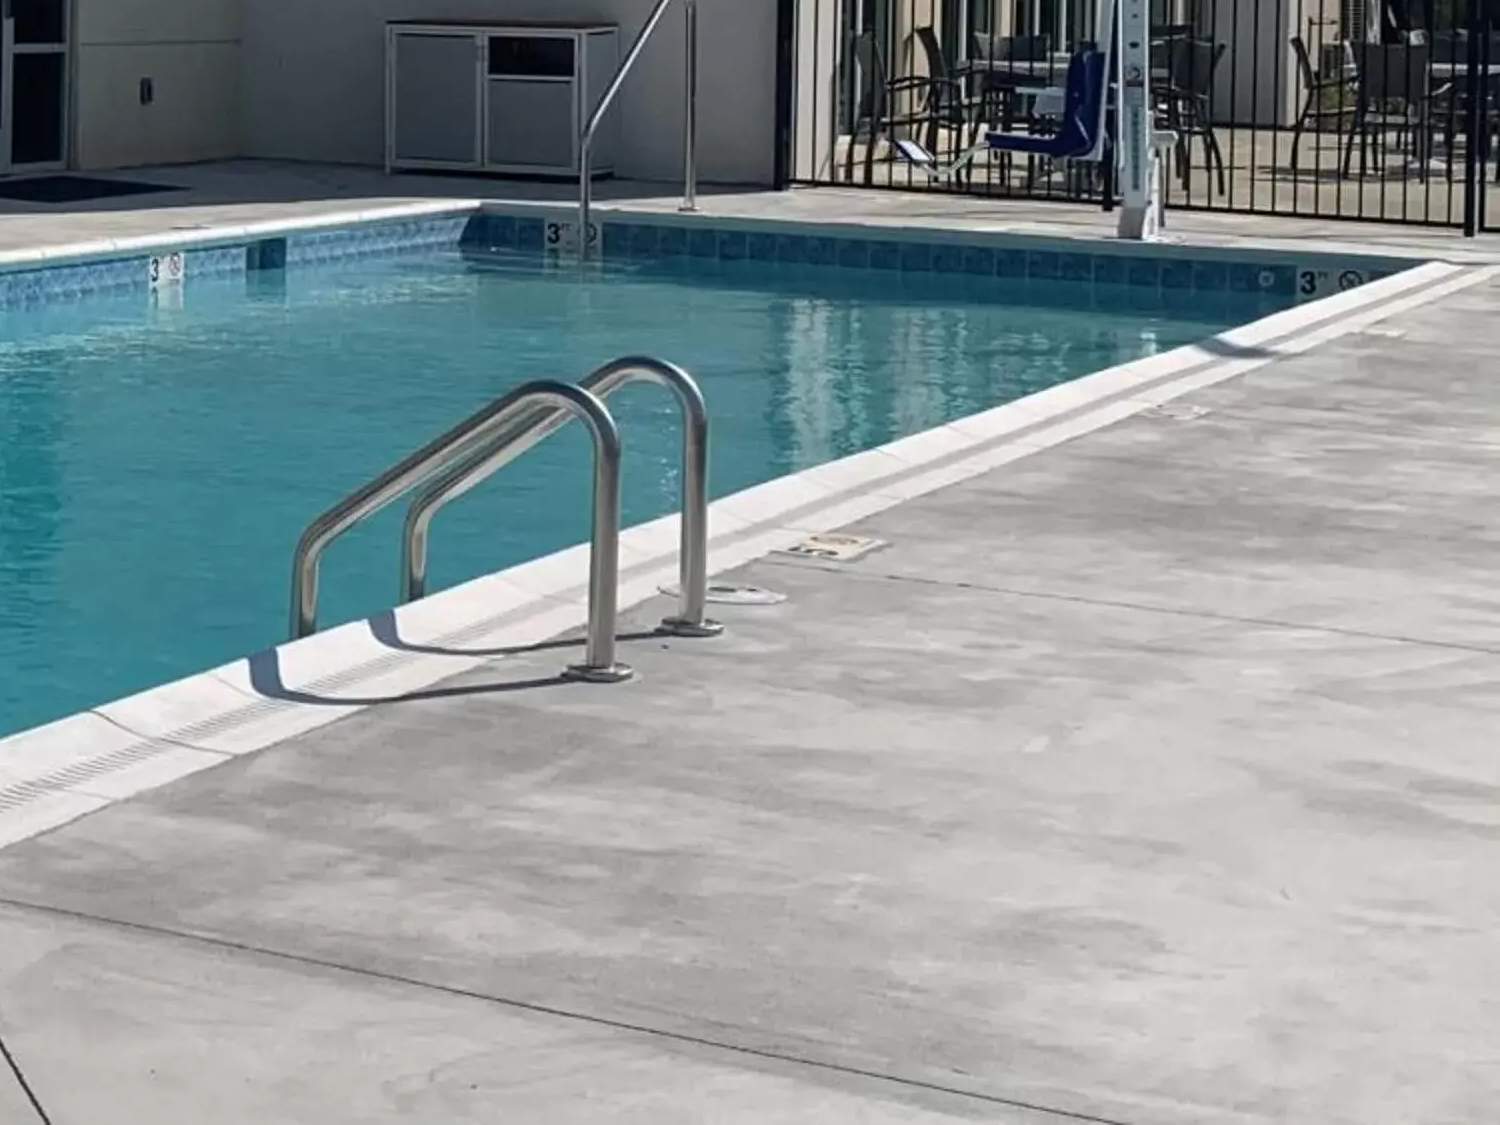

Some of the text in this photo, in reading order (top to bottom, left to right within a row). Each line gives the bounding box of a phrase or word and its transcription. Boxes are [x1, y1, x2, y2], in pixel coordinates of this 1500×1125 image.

[547, 222, 560, 244] 3
[151, 257, 159, 282] 3
[1300, 270, 1317, 294] 3
